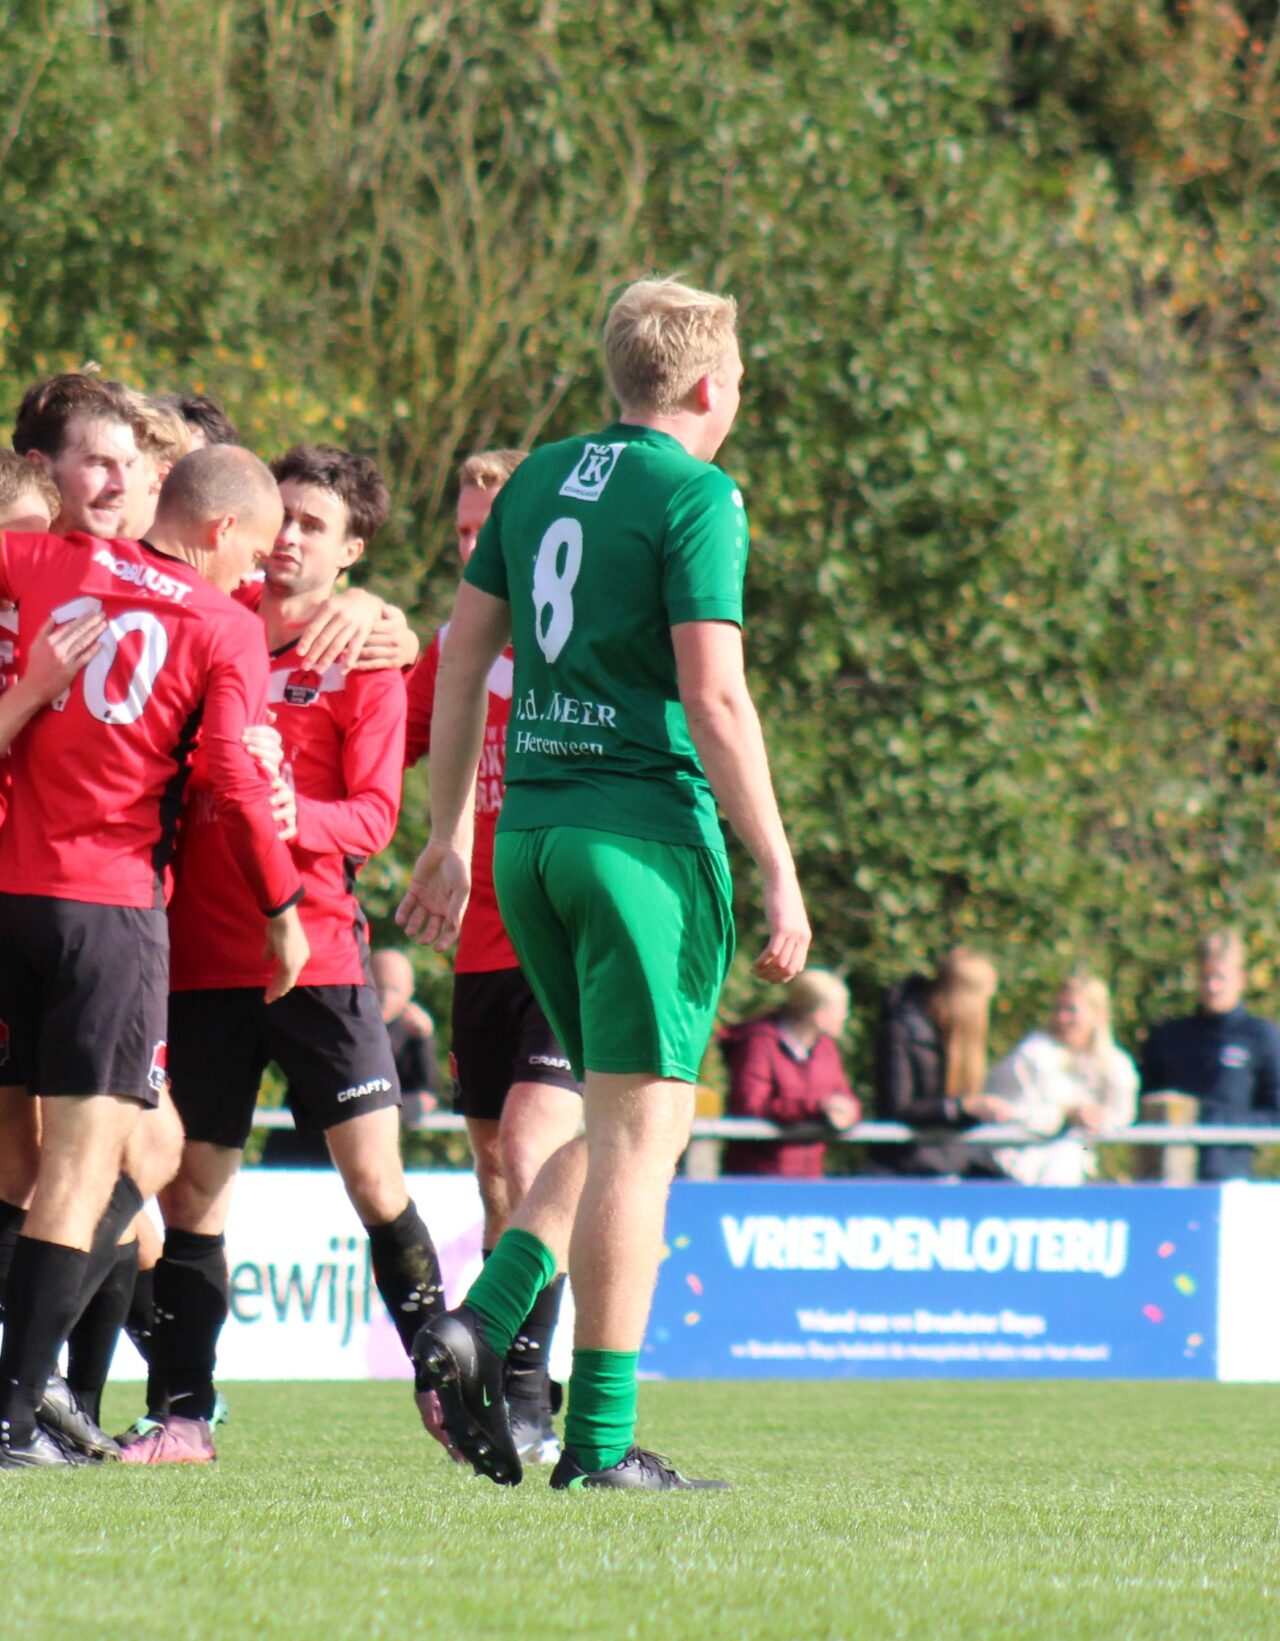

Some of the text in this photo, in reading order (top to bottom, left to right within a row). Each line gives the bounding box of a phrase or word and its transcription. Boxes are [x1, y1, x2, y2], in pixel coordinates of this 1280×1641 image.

[580, 454, 610, 482] K
[532, 516, 584, 664] 8
[337, 1079, 382, 1103] CRAFT
[721, 1215, 1130, 1279] VRIENDENLOTERIJ
